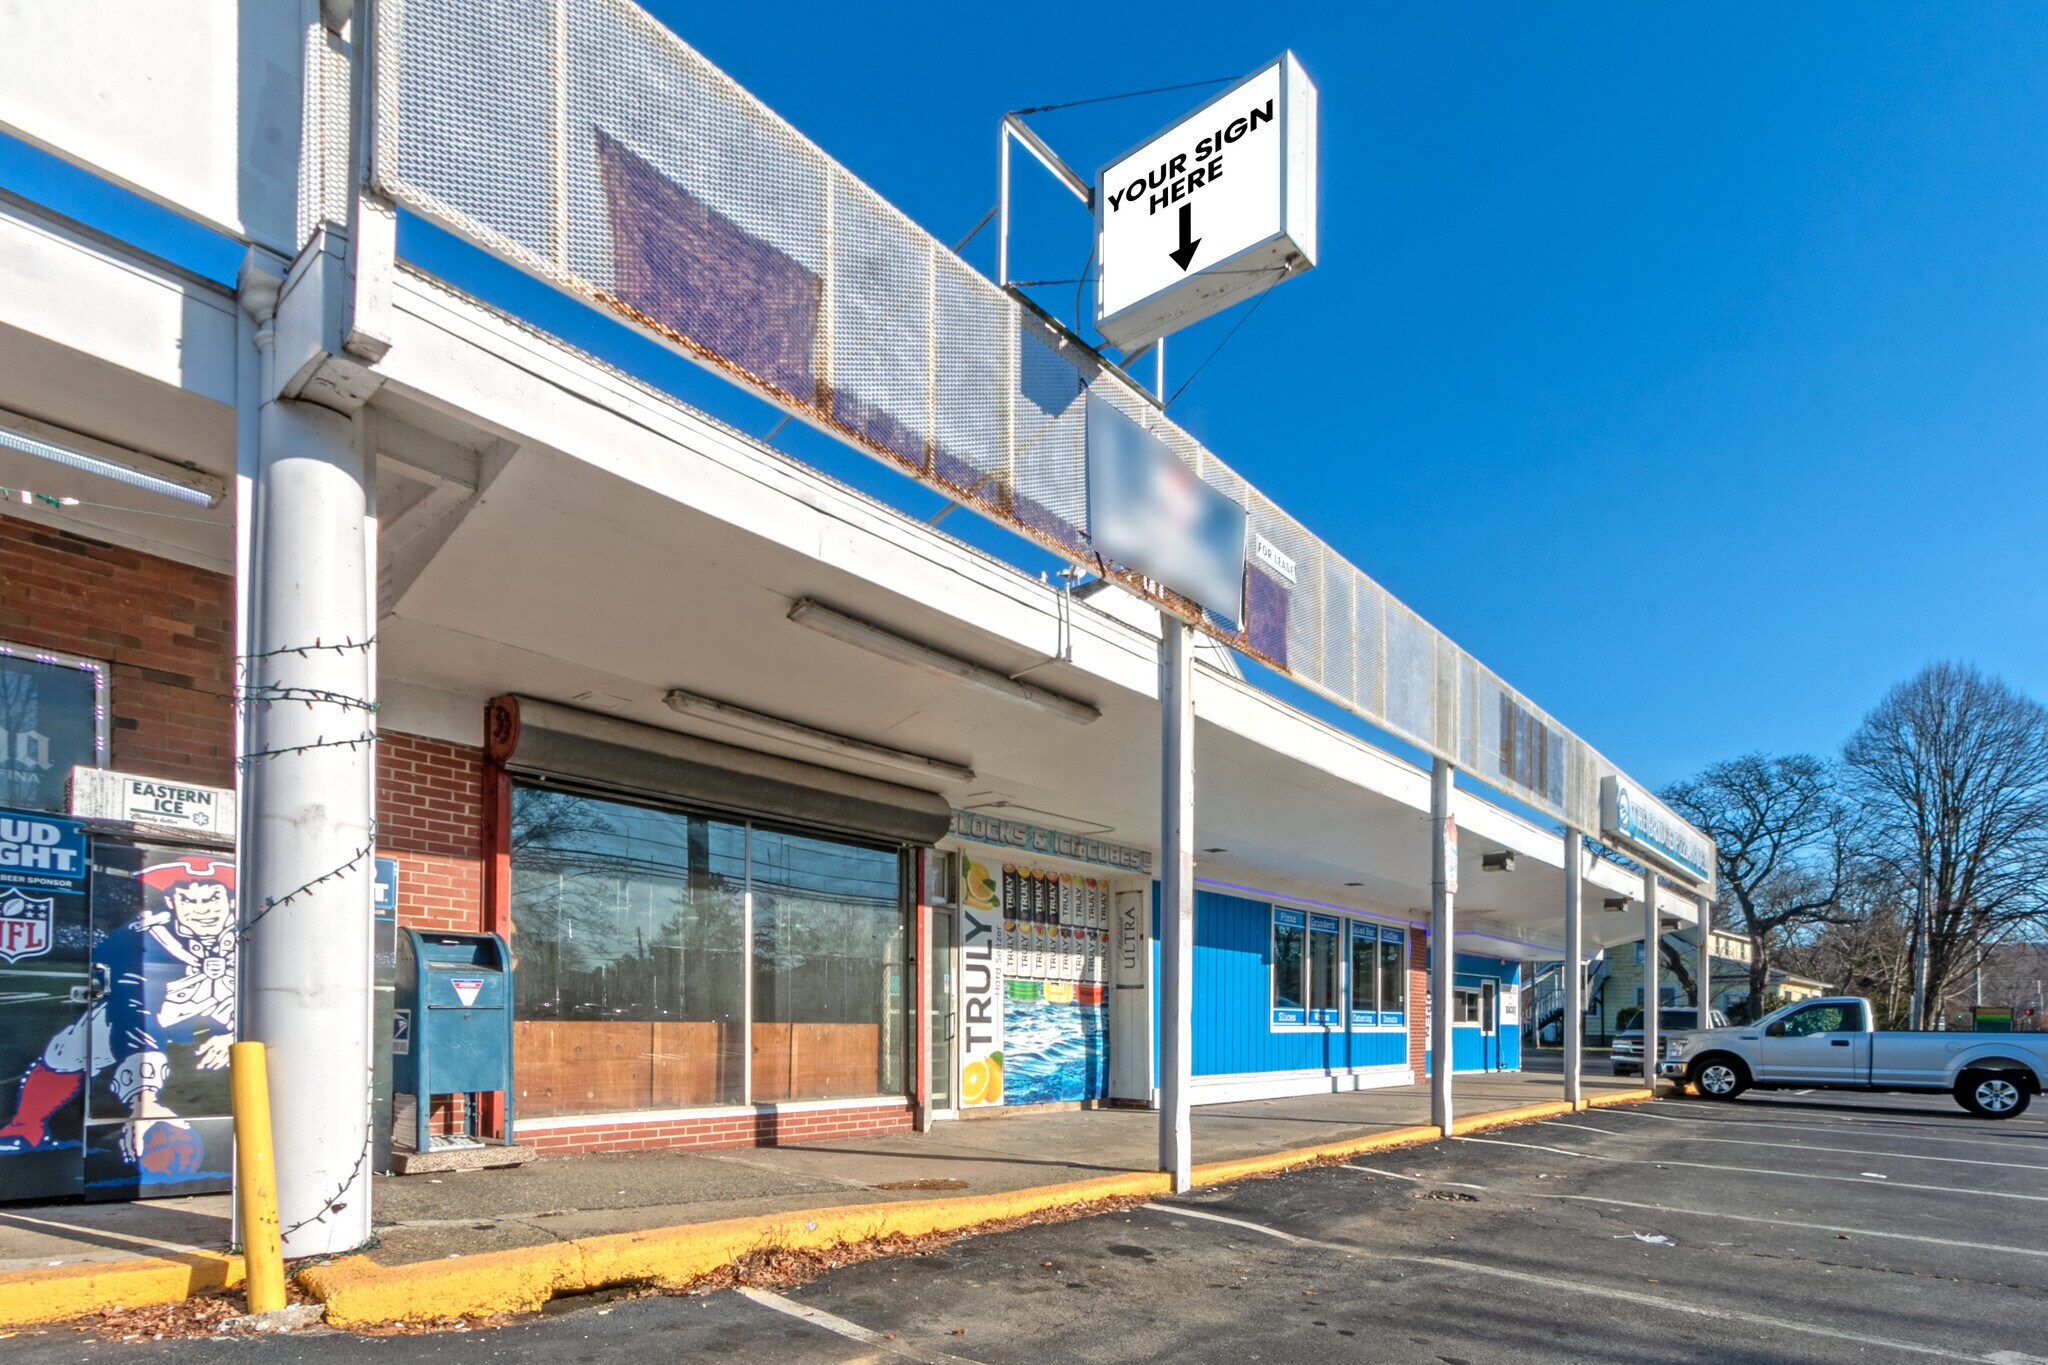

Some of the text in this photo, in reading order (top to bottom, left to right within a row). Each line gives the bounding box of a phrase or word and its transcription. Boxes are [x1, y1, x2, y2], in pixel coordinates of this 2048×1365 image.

[1107, 98, 1274, 213] YOUR SIGN
[1150, 155, 1223, 216] HERE
[1257, 541, 1294, 576] FOR LEASE
[132, 782, 212, 805] EASTERN
[154, 798, 184, 814] ICE
[0, 818, 61, 846] UD
[0, 841, 77, 871] GHT.
[1033, 830, 1048, 852] &
[1087, 840, 1140, 869] CUBES
[0, 874, 73, 887] BEER SPONSOR
[1020, 878, 1028, 912] TRULY
[1006, 934, 1014, 967] TRULY
[1124, 906, 1136, 969] ULTRA
[964, 910, 992, 1053] TRULY
[1278, 1012, 1297, 1022] Slices
[1353, 1013, 1373, 1023] Catering
